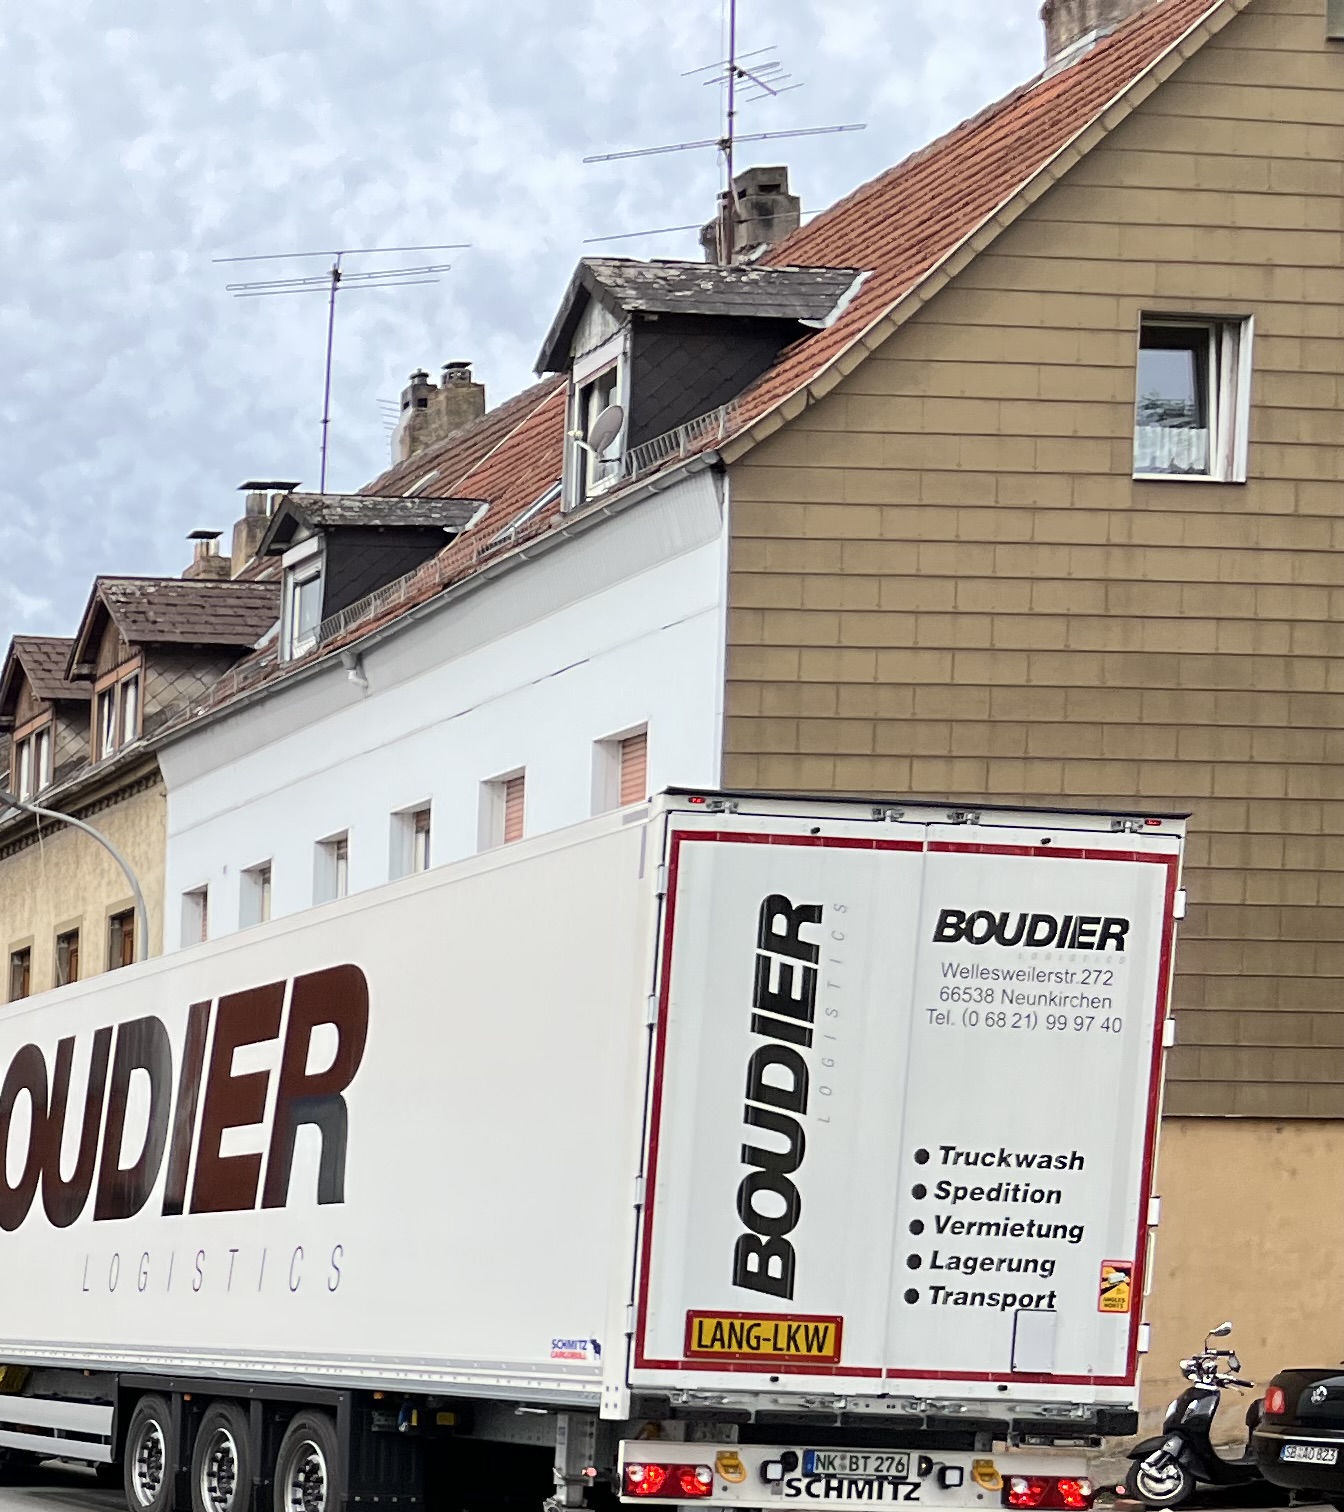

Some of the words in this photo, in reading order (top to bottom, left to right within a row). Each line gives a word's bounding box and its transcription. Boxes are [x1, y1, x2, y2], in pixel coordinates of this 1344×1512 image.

[932, 908, 1130, 952] BOUDIER
[939, 986, 995, 1004] 66538
[1001, 988, 1112, 1009] Neunkirchen
[817, 902, 848, 1124] LOGISTICS
[926, 1008, 956, 1026] Tel.
[985, 1011, 1007, 1028] 68
[1011, 1011, 1038, 1031] 21)
[1046, 1014, 1068, 1031] 99
[1073, 1015, 1095, 1032] 97
[1100, 1016, 1123, 1034] 40
[733, 893, 824, 1301] BOUDIER
[939, 1145, 1085, 1171] Truckwash
[934, 1180, 1062, 1205] Spedition
[934, 1214, 1085, 1244] Vermietung
[81, 1243, 347, 1295] LOGISTICS
[929, 1250, 1056, 1279] Lagerung
[929, 1285, 1057, 1312] Transport
[696, 1319, 830, 1354] LANG-LKW
[815, 1453, 837, 1472] NK
[848, 1454, 872, 1472] BT
[873, 1455, 906, 1474] 276
[784, 1477, 922, 1502] SCHMITZ
